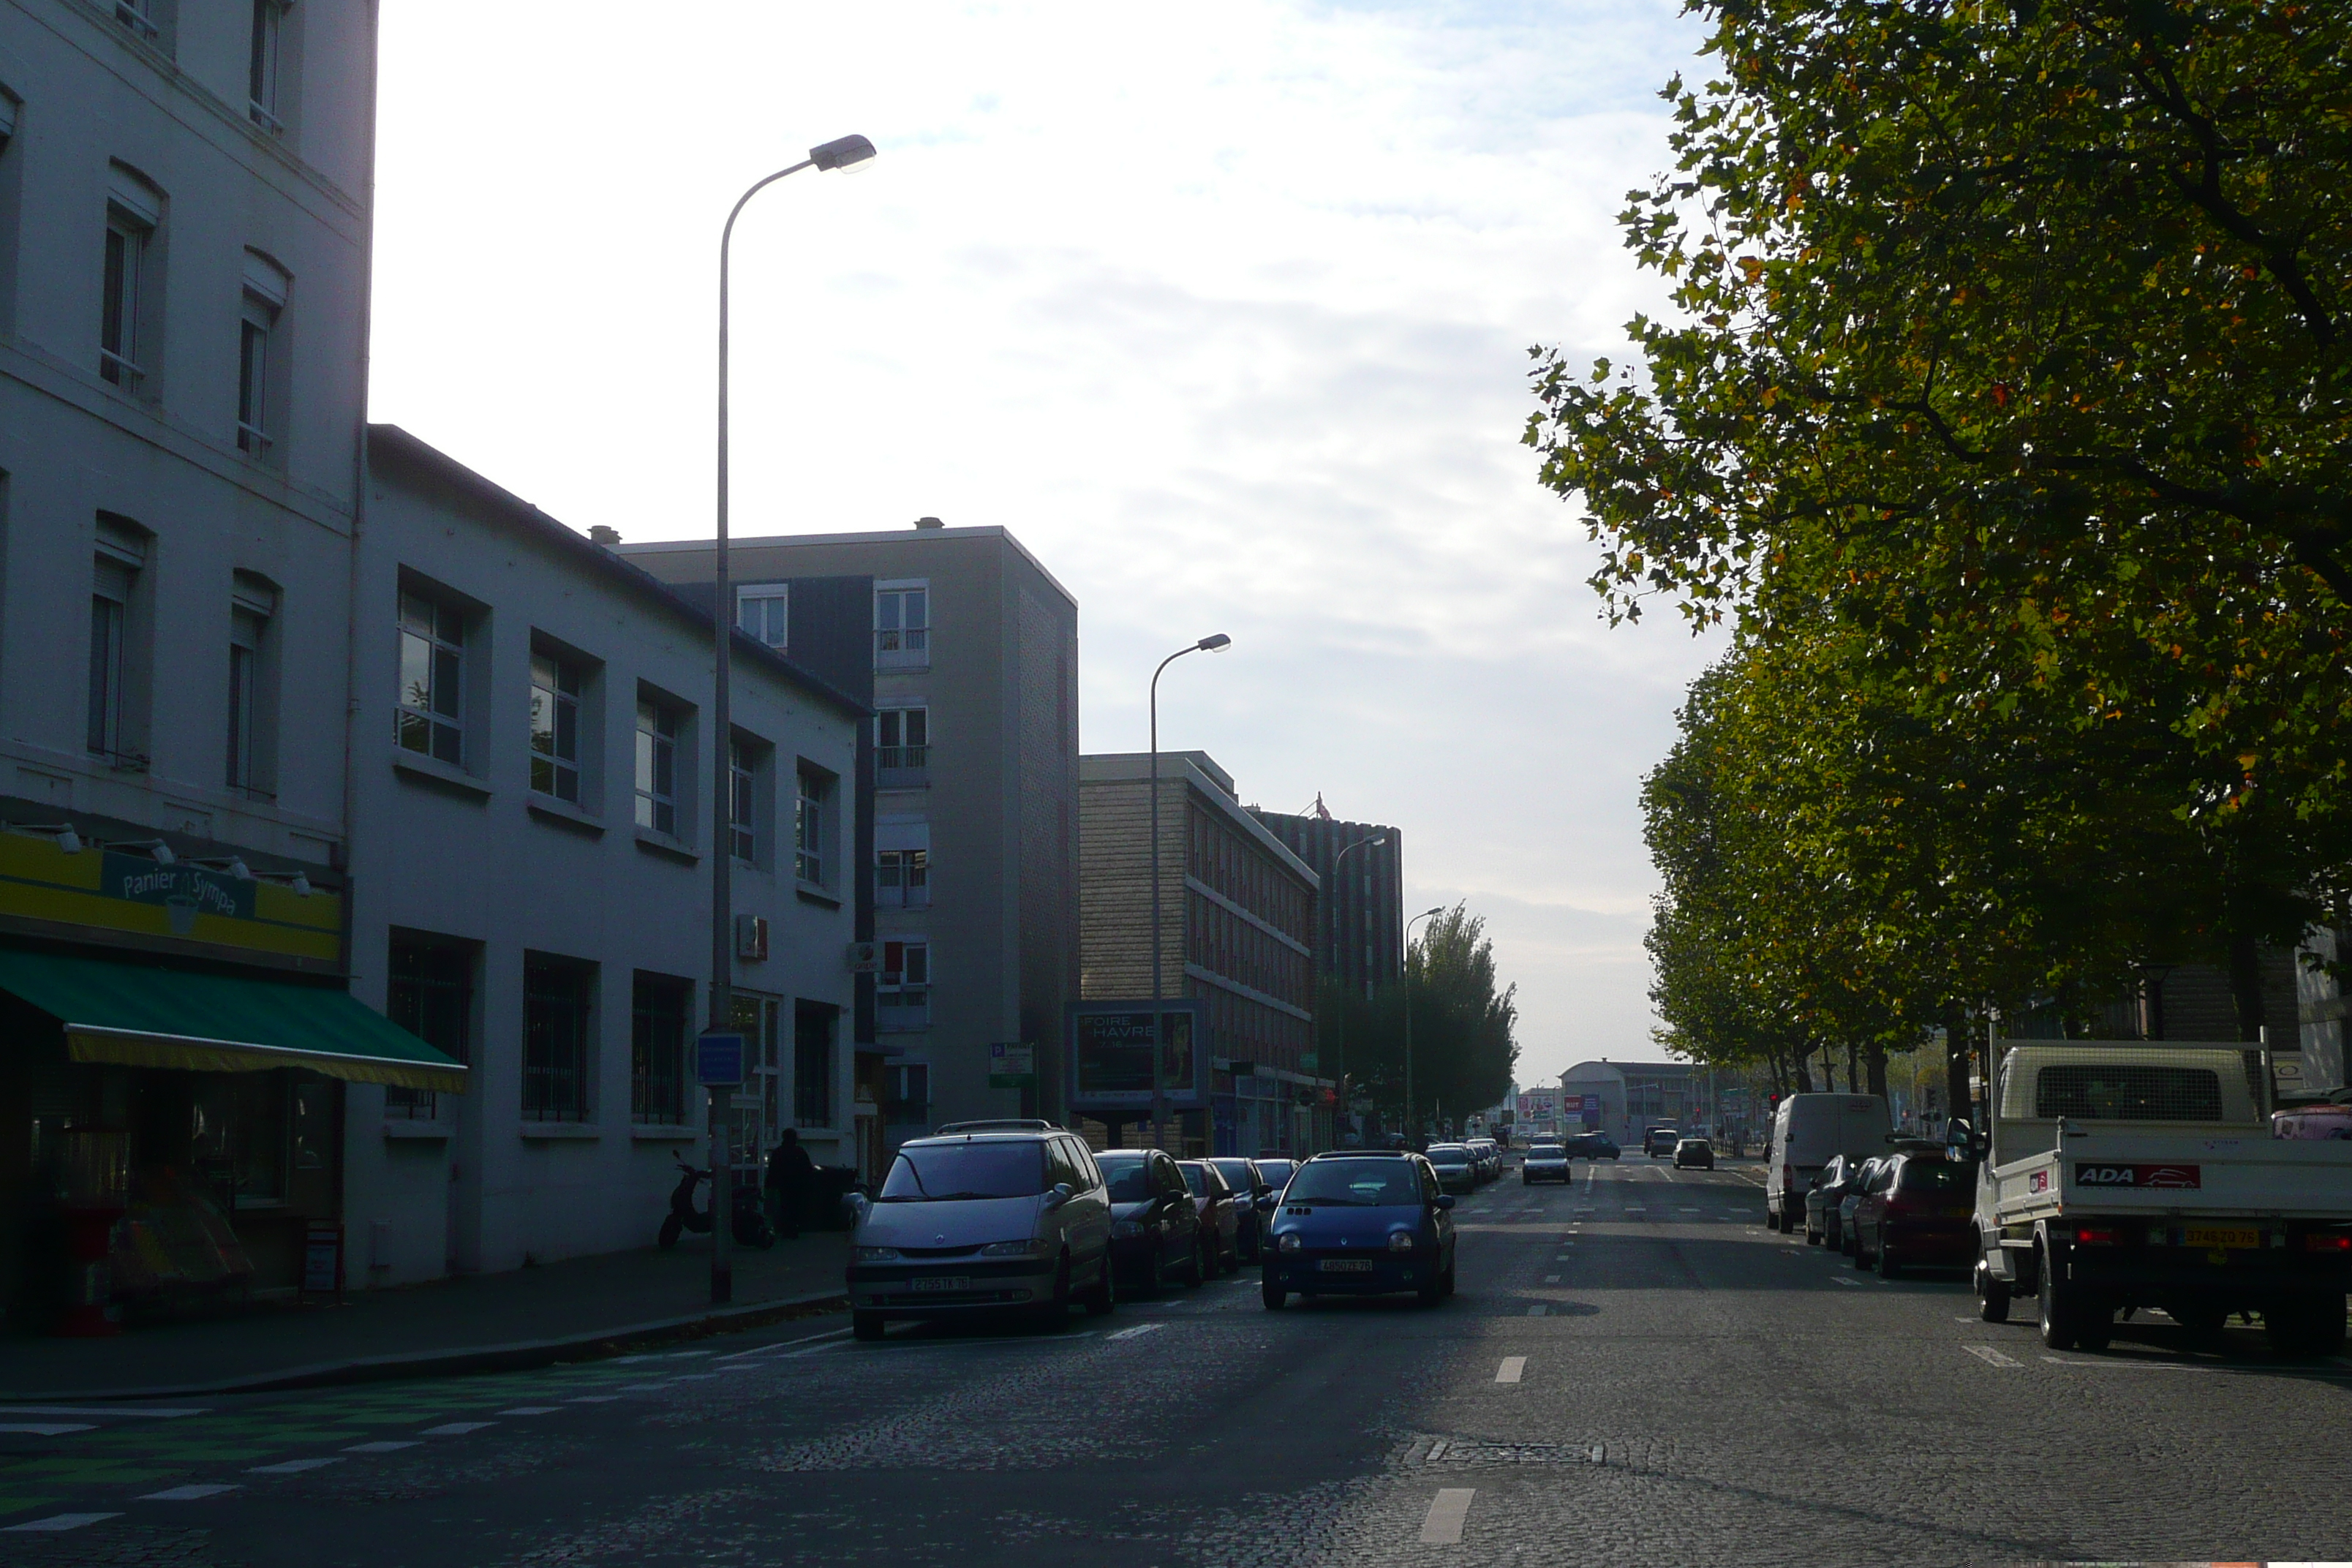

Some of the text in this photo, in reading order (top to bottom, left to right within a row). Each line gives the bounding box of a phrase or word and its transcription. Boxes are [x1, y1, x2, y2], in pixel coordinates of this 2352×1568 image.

[123, 867, 236, 916] Panier Sympa
[1085, 1016, 1131, 1026] FOIRE
[1093, 1025, 1154, 1038] HAVRE
[2078, 1167, 2134, 1183] ADA
